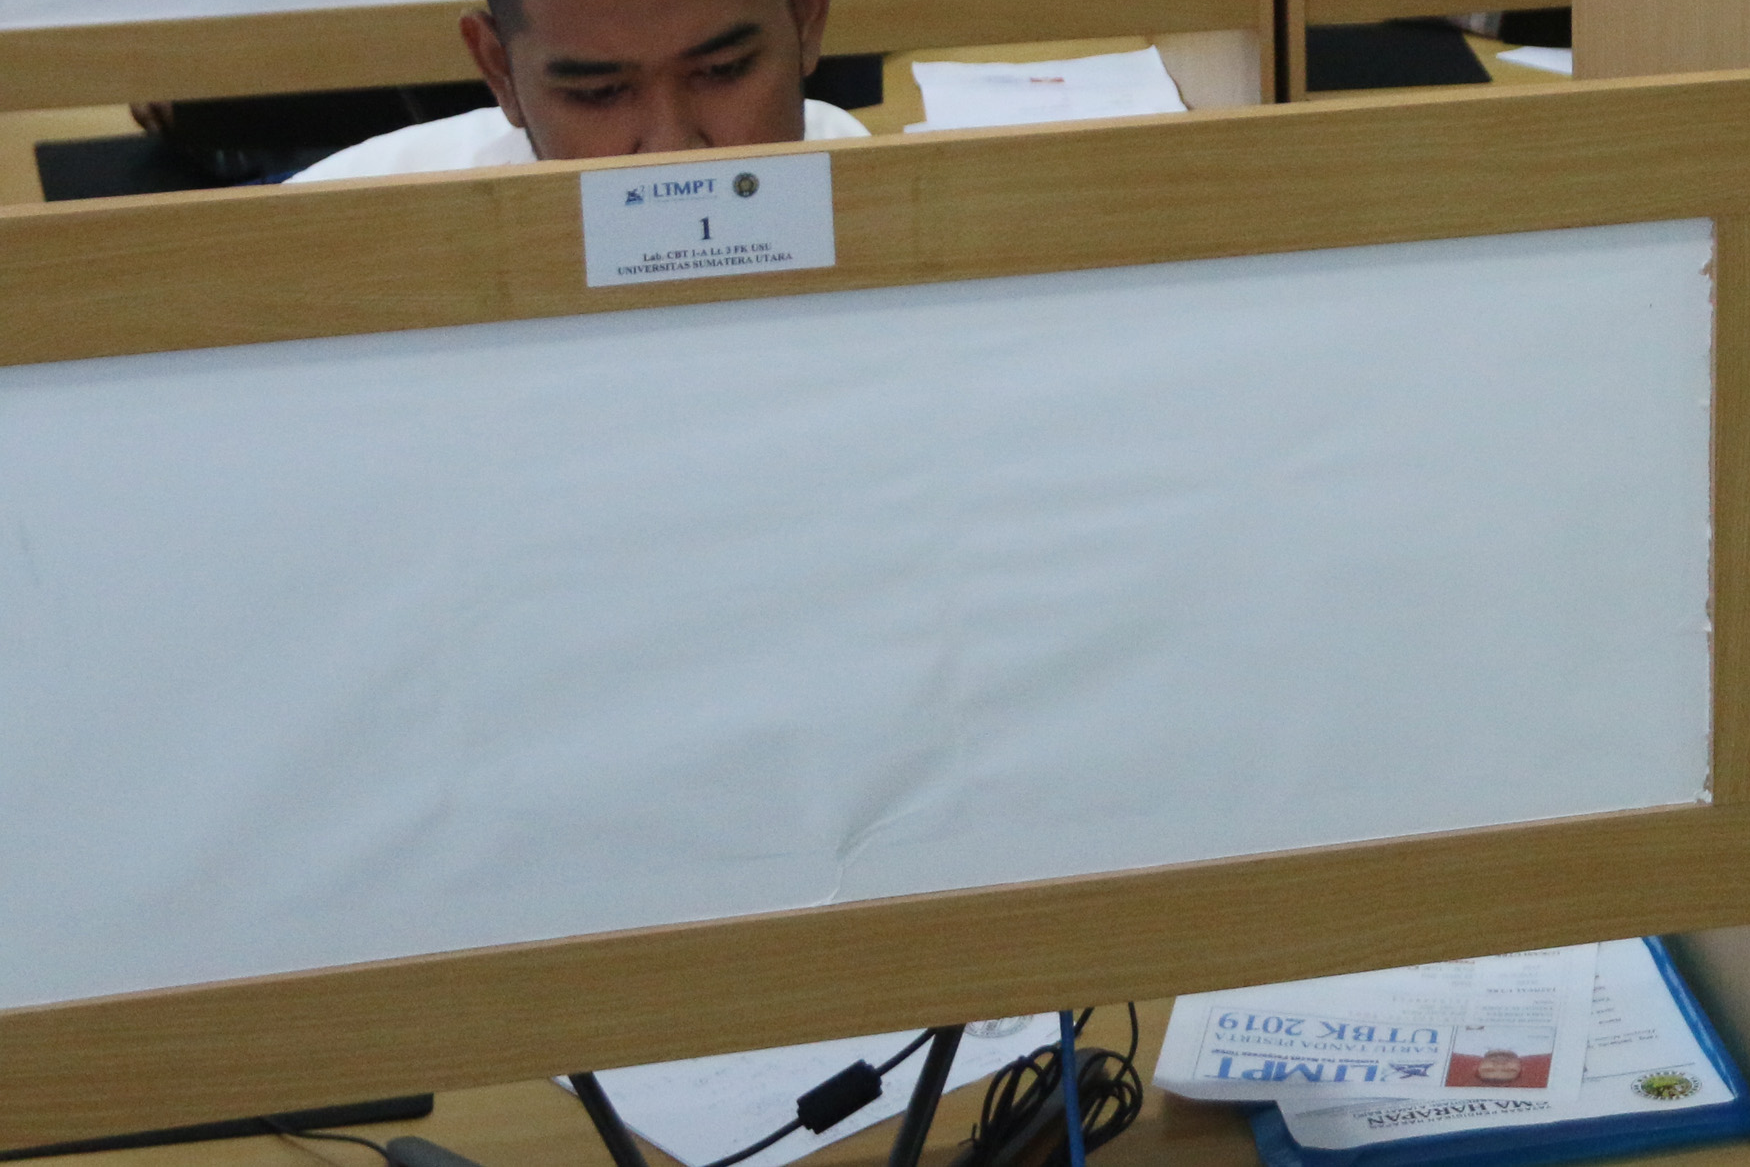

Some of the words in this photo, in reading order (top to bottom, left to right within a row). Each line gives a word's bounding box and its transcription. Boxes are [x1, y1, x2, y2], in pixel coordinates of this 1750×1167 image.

[652, 178, 718, 199] LTMPT
[699, 216, 713, 241] 1
[666, 249, 689, 260] CBT
[734, 244, 748, 254] FK
[751, 242, 772, 252] USU
[617, 262, 691, 276] UNIVERSITAS
[692, 257, 753, 270] SUMATERA
[755, 252, 794, 264] UTARA
[1216, 1012, 1306, 1037] 2019
[1317, 1021, 1440, 1045] UTBK
[1212, 1032, 1295, 1047] PESERTA
[1301, 1040, 1366, 1054] TANDA
[1371, 1044, 1439, 1055] KARTU
[1204, 1055, 1379, 1083] LTMPT
[1367, 1102, 1487, 1125] HARAPAN
